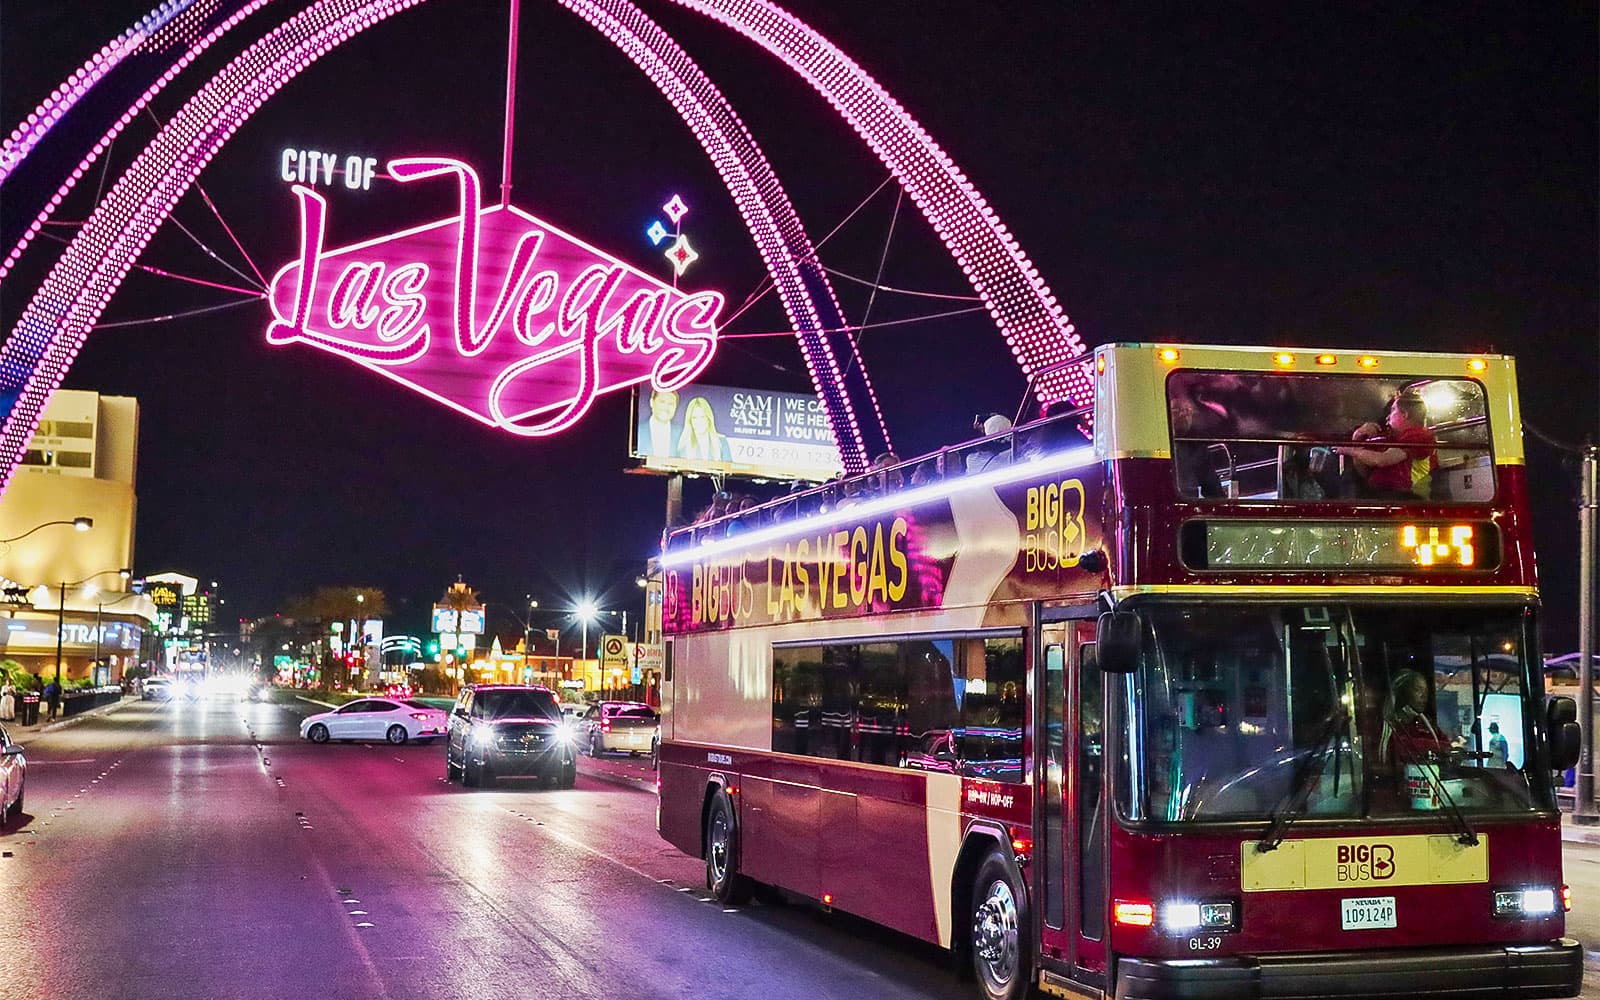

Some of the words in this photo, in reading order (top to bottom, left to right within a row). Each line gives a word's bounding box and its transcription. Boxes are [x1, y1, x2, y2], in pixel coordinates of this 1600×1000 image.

[281, 147, 338, 186] CITY
[345, 156, 378, 191] OF
[266, 184, 431, 366] Las
[387, 157, 726, 437] Vegas
[733, 393, 772, 411] SAM
[785, 398, 805, 411] WE
[807, 401, 826, 413] CA
[785, 412, 805, 425] WE
[807, 414, 829, 427] HEL
[784, 425, 812, 439] YOU
[737, 445, 765, 458] 702
[1027, 483, 1059, 531] BIG
[1026, 531, 1059, 573] BUS
[766, 538, 811, 617] LAS
[816, 517, 908, 610] VEGAS
[991, 793, 1014, 808] HOP-OFF
[1337, 845, 1369, 863] BIG
[1337, 864, 1370, 881] BUS
[1345, 906, 1393, 923] 109124P
[1189, 937, 1222, 950] GL-39
